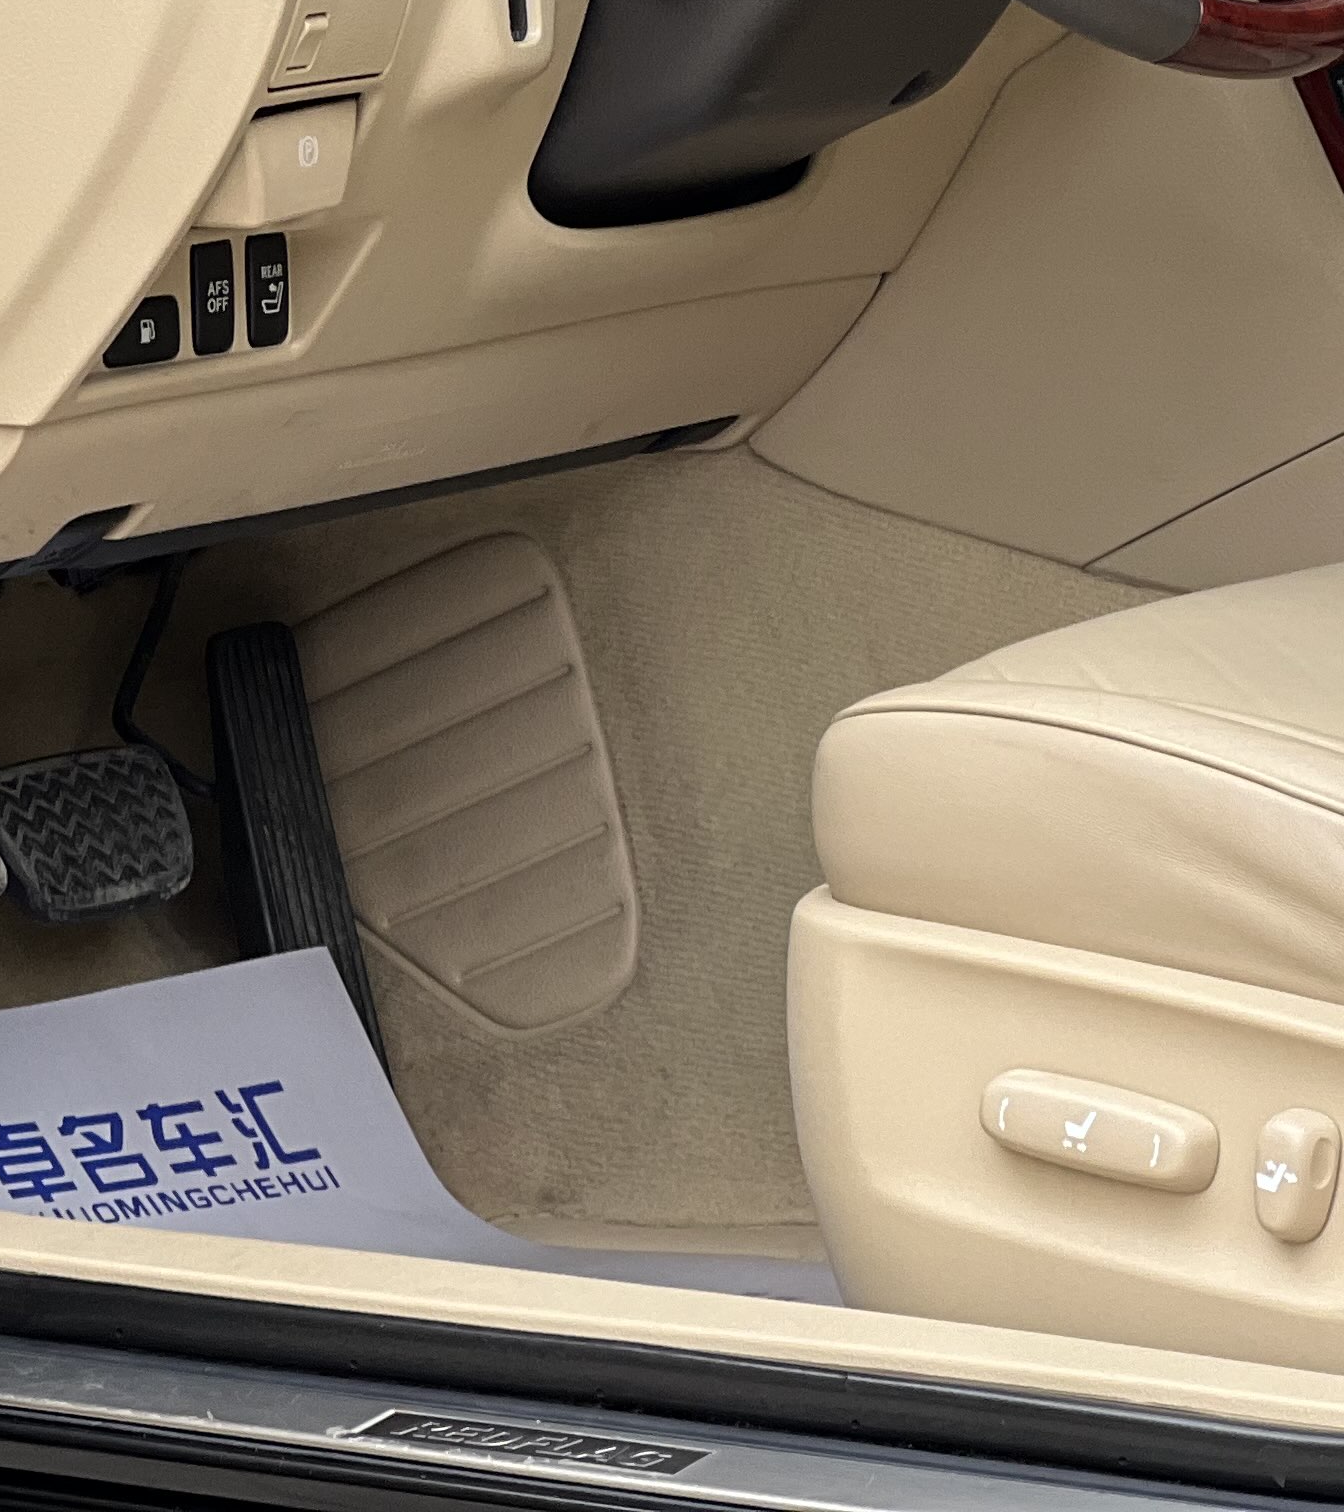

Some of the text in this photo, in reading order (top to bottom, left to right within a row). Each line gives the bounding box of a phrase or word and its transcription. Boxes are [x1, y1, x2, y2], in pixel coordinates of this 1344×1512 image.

[261, 264, 283, 279] REAR
[207, 279, 230, 297] AFS
[207, 297, 229, 313] OFF
[389, 1421, 673, 1468] REDFLAG
